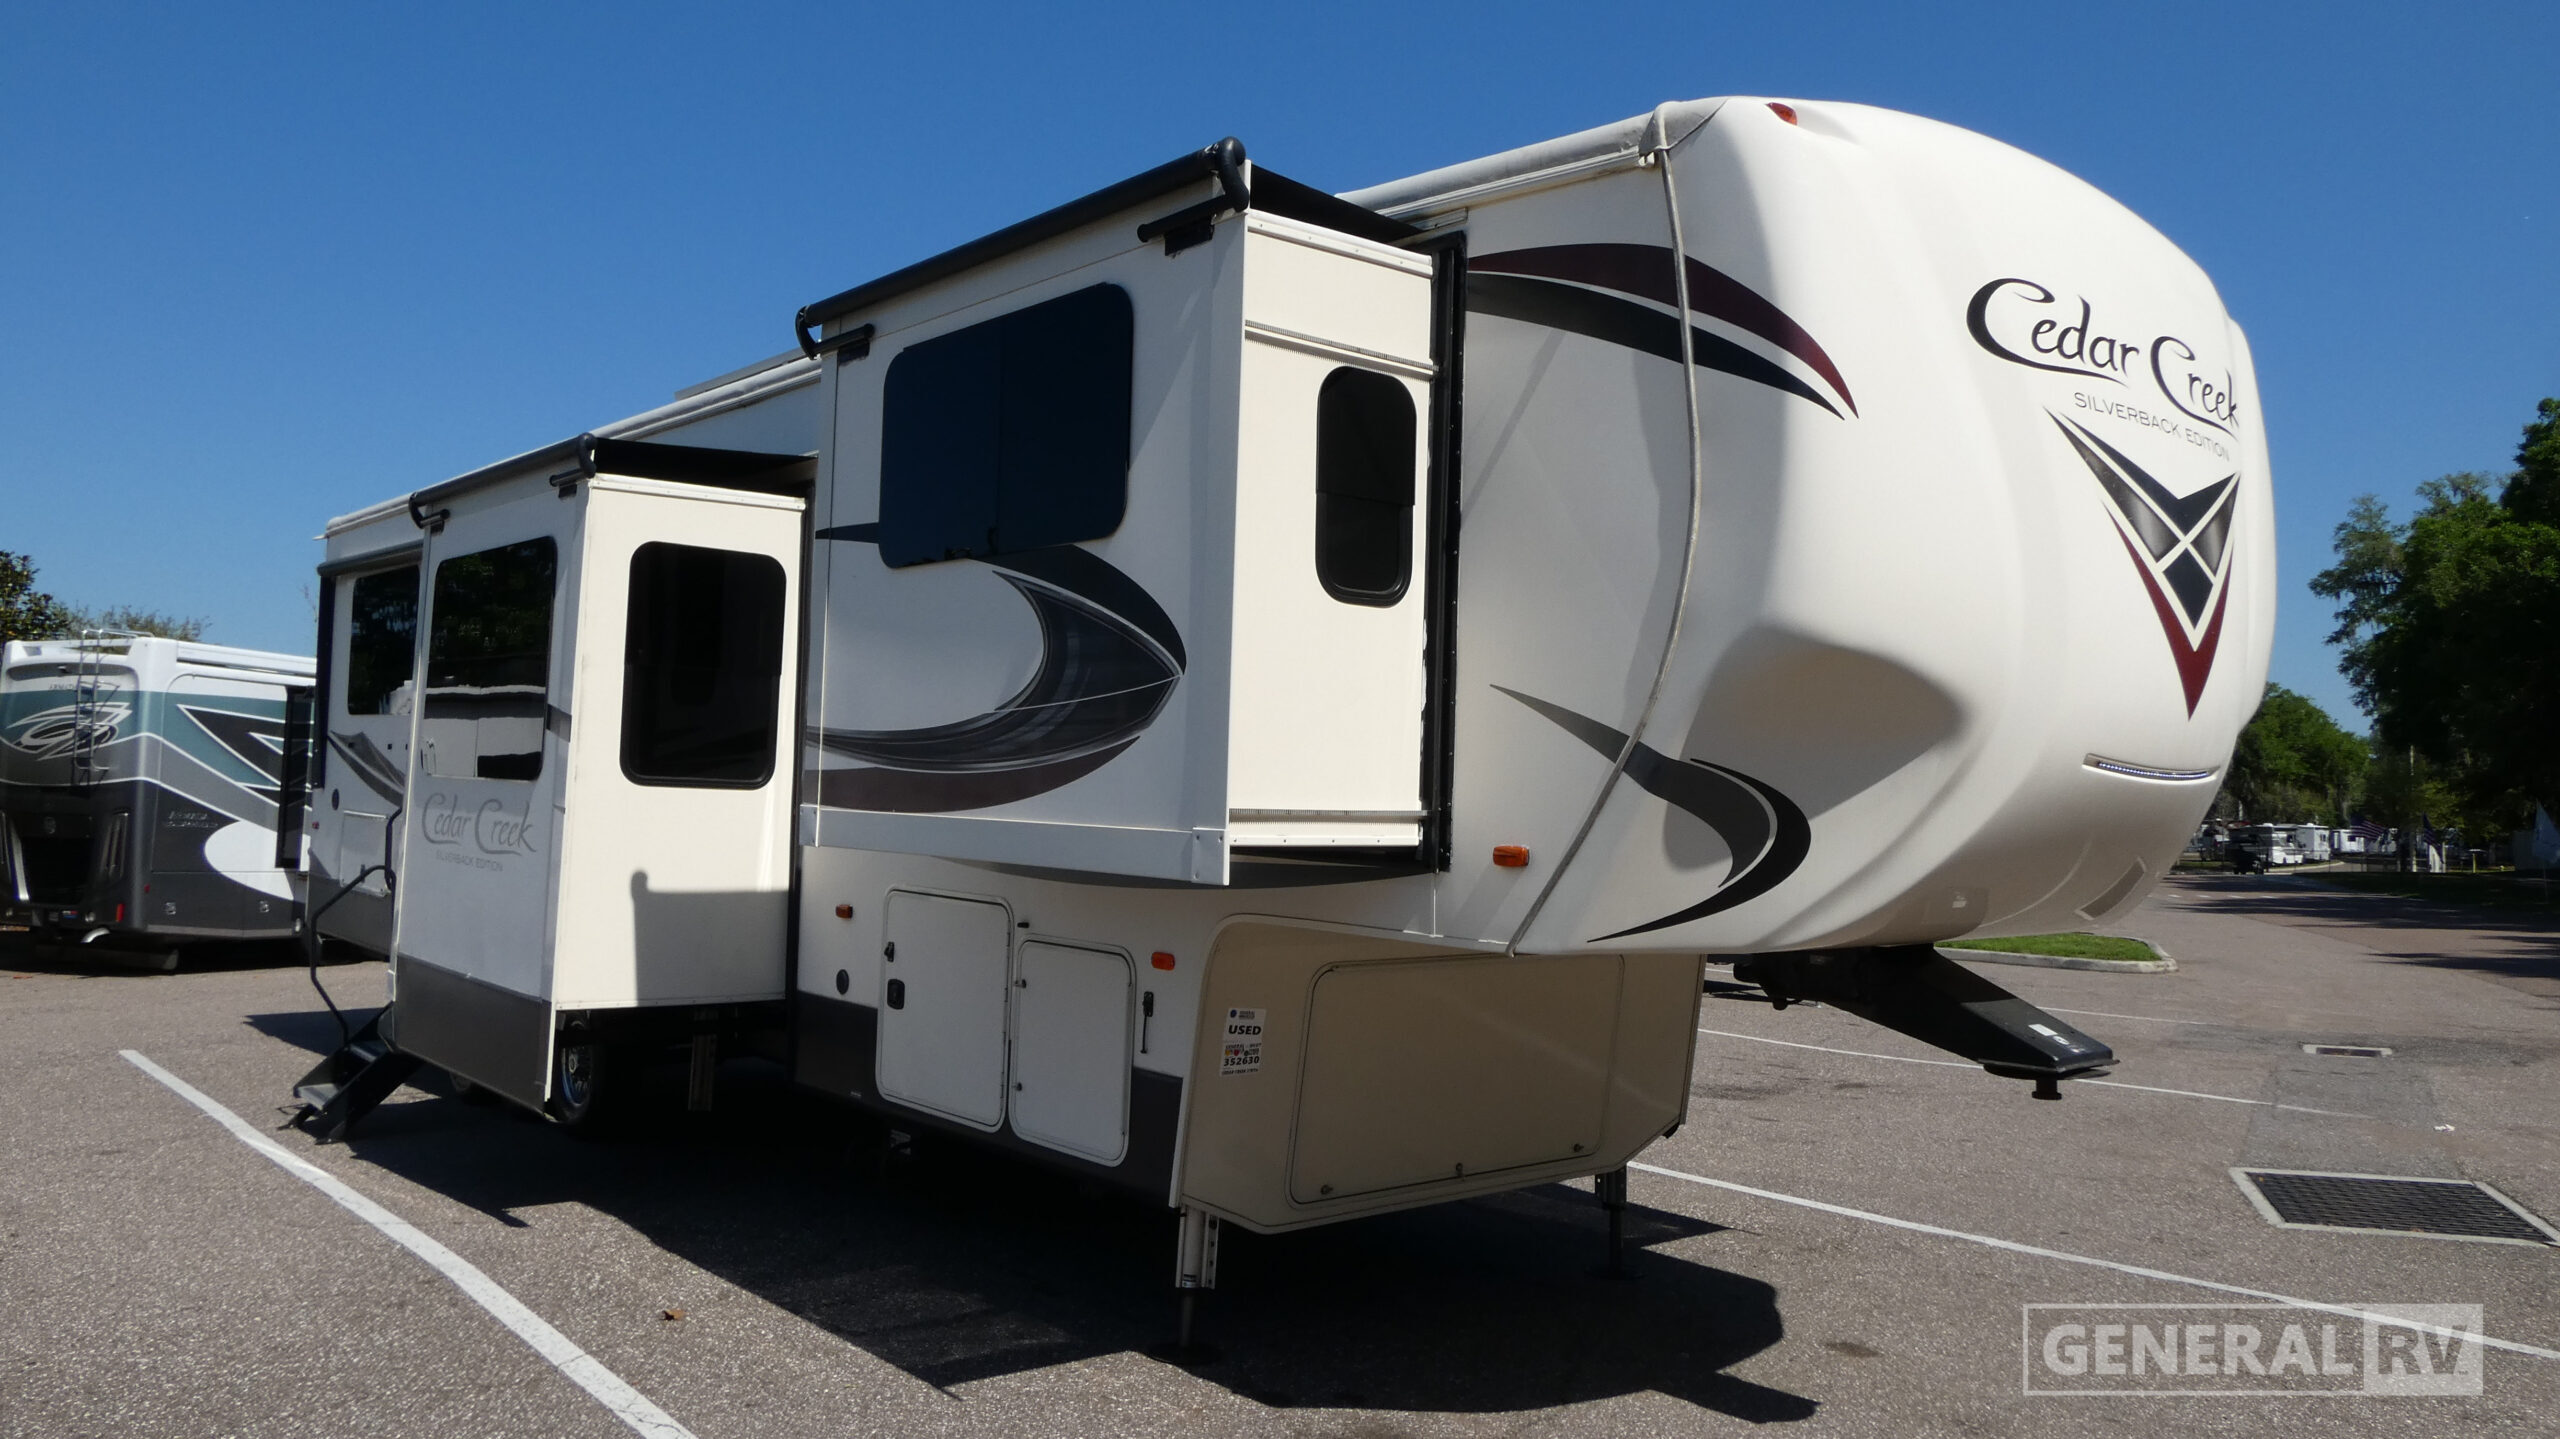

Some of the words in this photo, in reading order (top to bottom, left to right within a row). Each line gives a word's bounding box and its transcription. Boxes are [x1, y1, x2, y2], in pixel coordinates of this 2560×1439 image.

[1966, 278, 2139, 388] Cedar
[2150, 335, 2239, 441] Creek
[2074, 392, 2182, 438] SILVERBACK
[2185, 428, 2230, 462] EDITION
[422, 792, 471, 846] Cedar
[474, 798, 536, 856] Creek
[1228, 1025, 1262, 1035] USED
